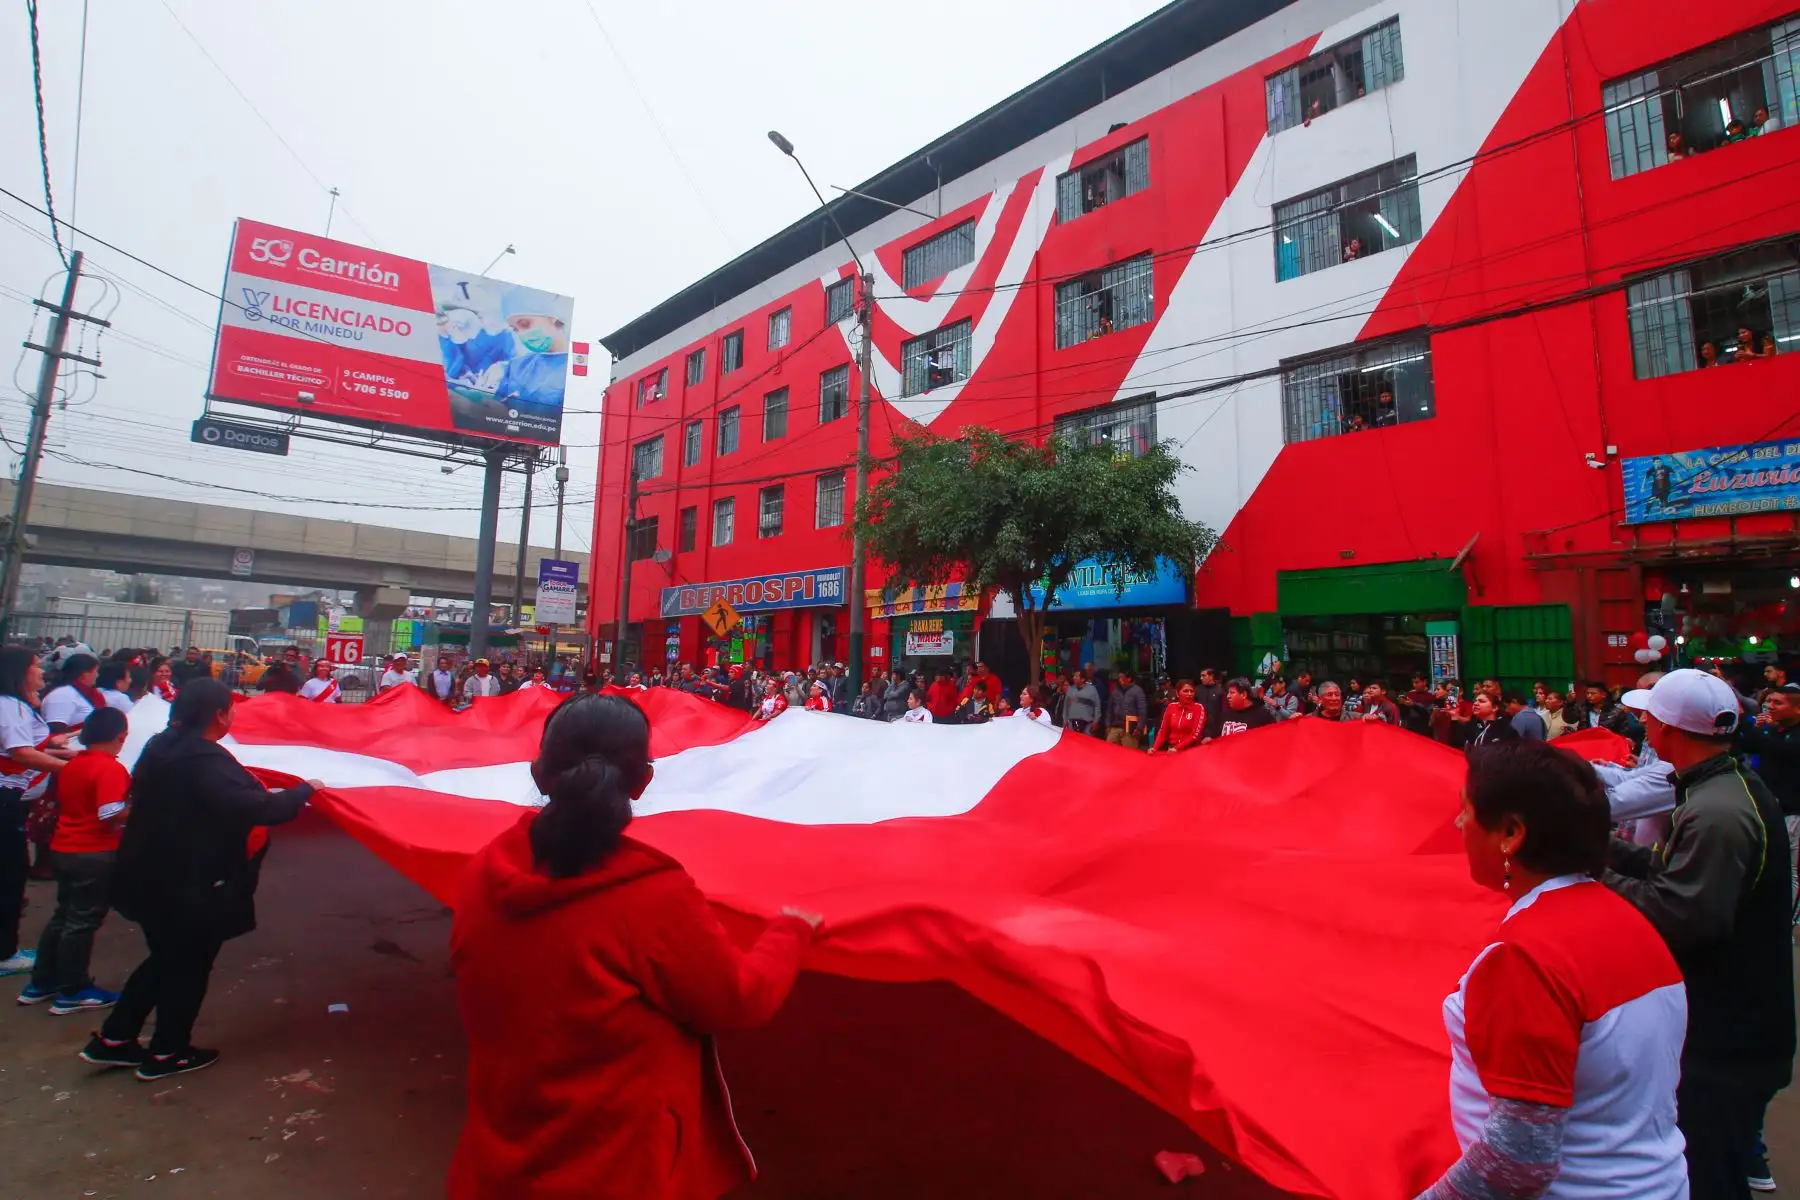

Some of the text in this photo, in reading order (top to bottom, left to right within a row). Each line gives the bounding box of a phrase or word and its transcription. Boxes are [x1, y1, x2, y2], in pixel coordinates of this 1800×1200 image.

[298, 248, 399, 287] Carrión
[272, 295, 412, 337] LICENCIADO
[270, 314, 364, 341] POR MINEDU
[237, 365, 285, 379] BACHILLER
[343, 369, 395, 385] 9 CAMPUS
[354, 382, 410, 400] 706 5500
[224, 429, 279, 447] Dardos
[1687, 457, 1705, 469] LA
[1709, 449, 1750, 465] CASA
[1753, 443, 1781, 459] DEL
[1693, 498, 1779, 517] HUMBOLDT
[680, 575, 815, 609] BERROSPI
[817, 580, 840, 598] 1686
[331, 641, 358, 663] 16
